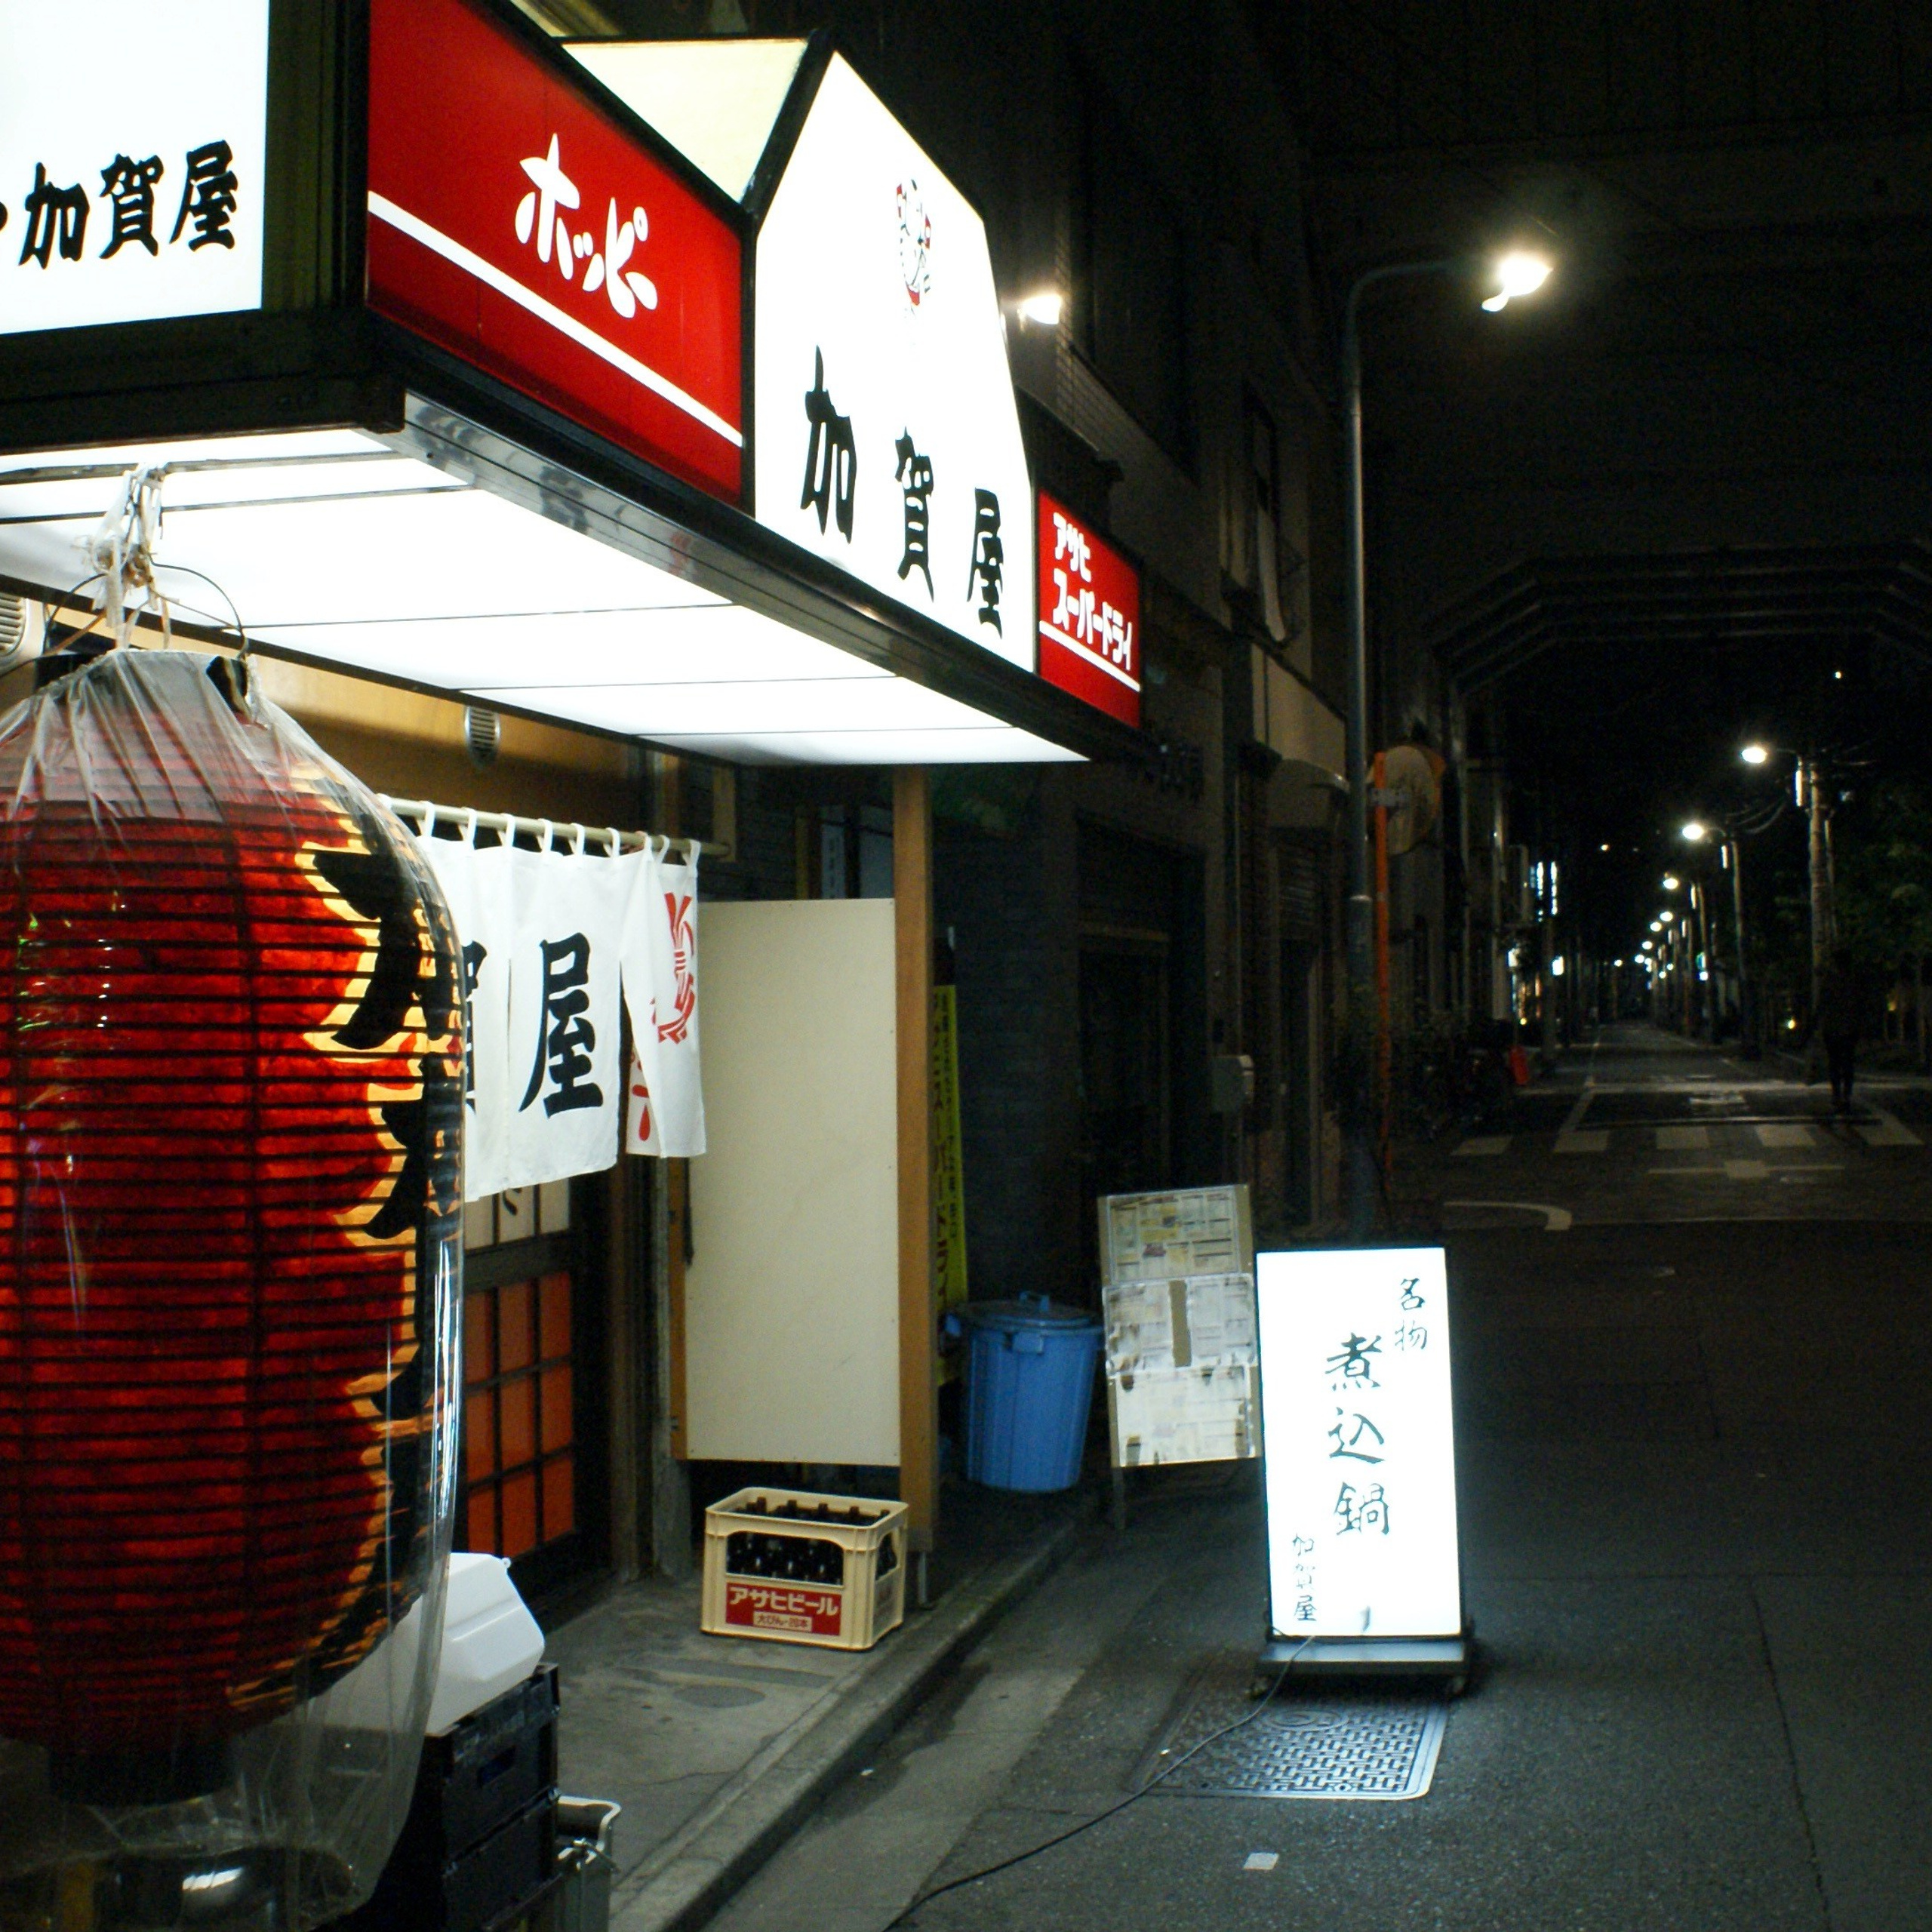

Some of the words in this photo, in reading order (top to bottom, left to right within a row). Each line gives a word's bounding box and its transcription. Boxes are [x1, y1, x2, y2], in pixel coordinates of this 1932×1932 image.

[801, 345, 1004, 639] 加賀屋
[1053, 512, 1091, 583] アサヒ
[1053, 568, 1133, 671] スーパードライ
[1395, 1277, 1429, 1352] 名物
[1325, 1332, 1391, 1537] 煮込鍋
[729, 1586, 839, 1617] アサヒビール
[1291, 1532, 1318, 1623] 加賀屋
